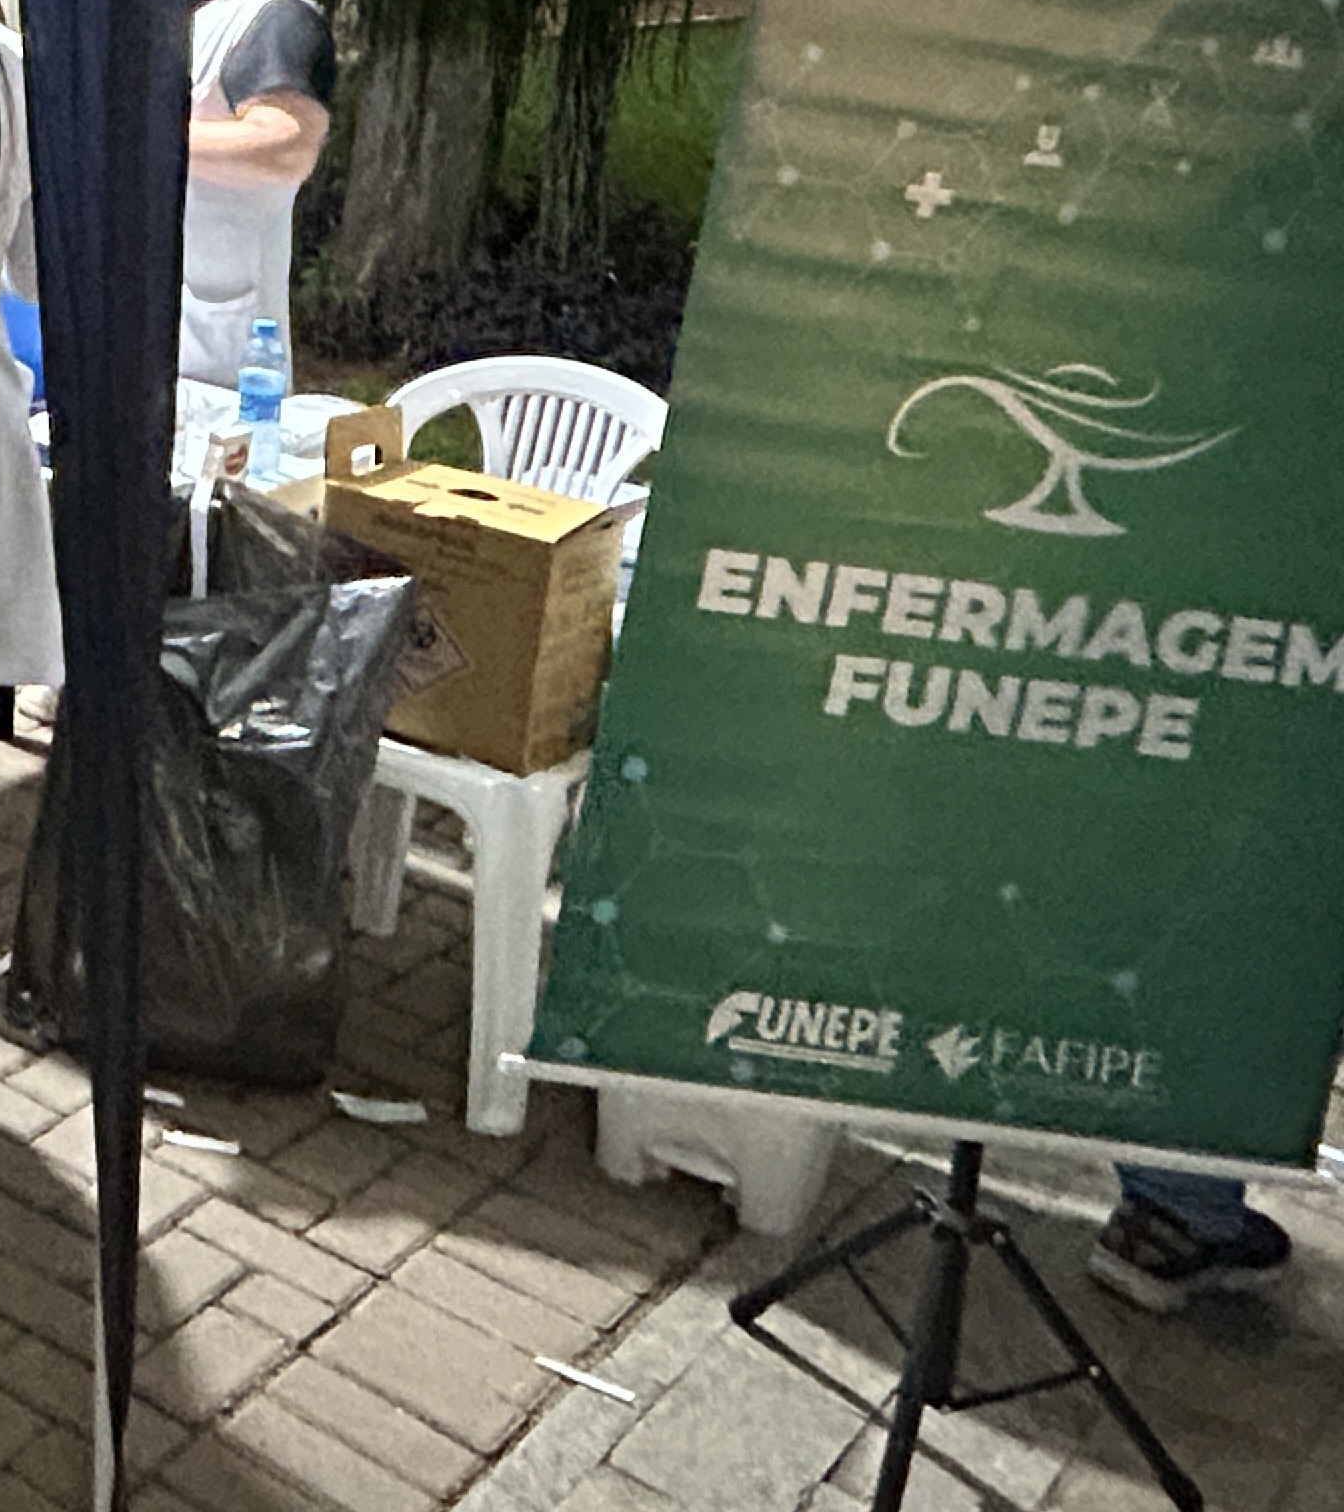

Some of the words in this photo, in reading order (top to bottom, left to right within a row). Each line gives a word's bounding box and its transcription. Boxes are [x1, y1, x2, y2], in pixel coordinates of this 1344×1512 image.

[697, 548, 1344, 695] ENFERMAGEM
[823, 654, 1200, 761] FUNEPE
[992, 1026, 1166, 1088] FAFIPE
